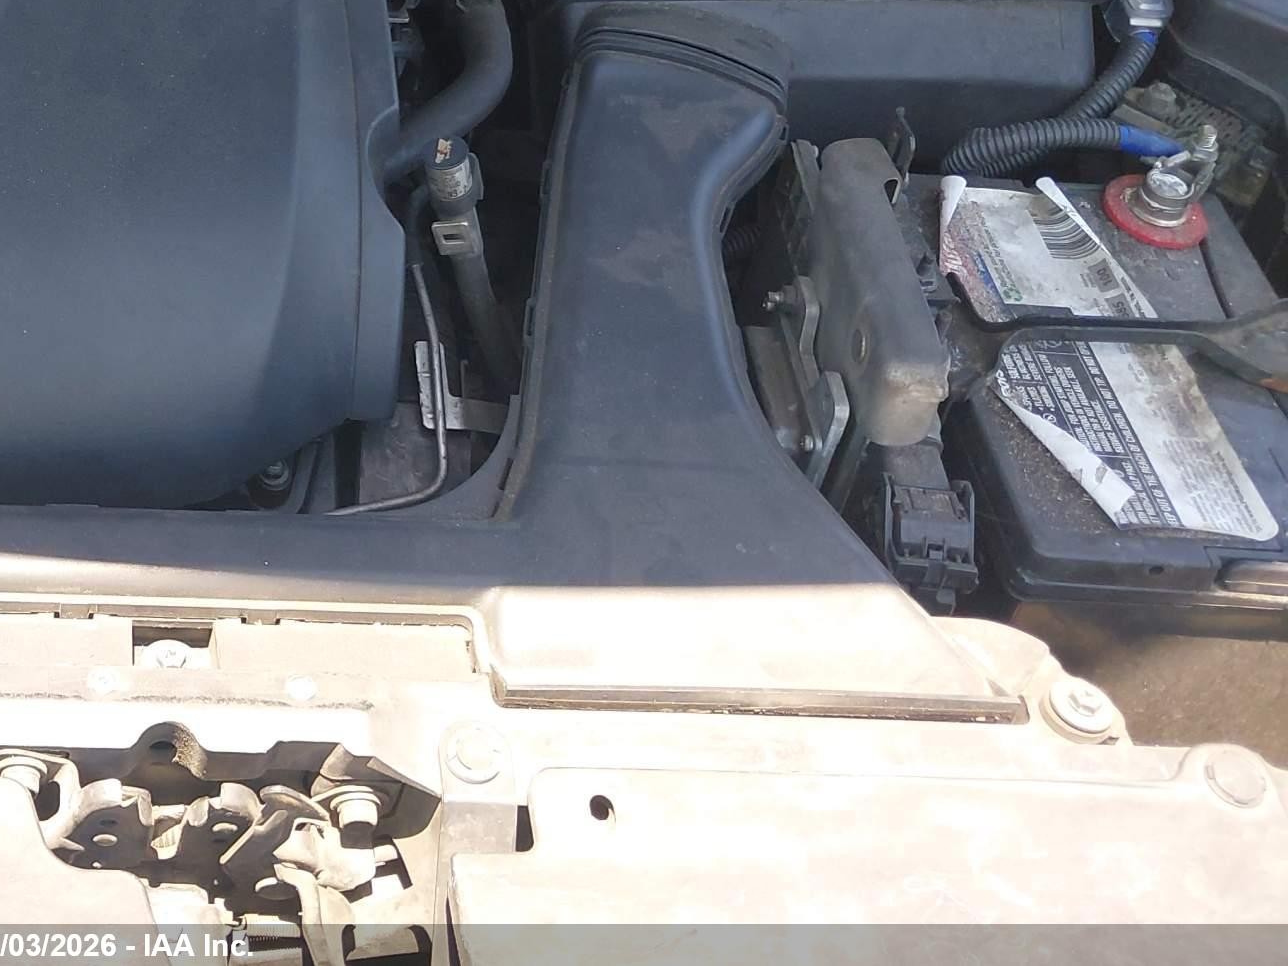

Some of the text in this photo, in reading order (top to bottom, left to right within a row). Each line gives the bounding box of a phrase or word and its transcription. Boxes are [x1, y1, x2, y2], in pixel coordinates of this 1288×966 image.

[1131, 452, 1153, 473] REACH
[1141, 472, 1160, 486] THE
[1154, 497, 1172, 511] OUT
